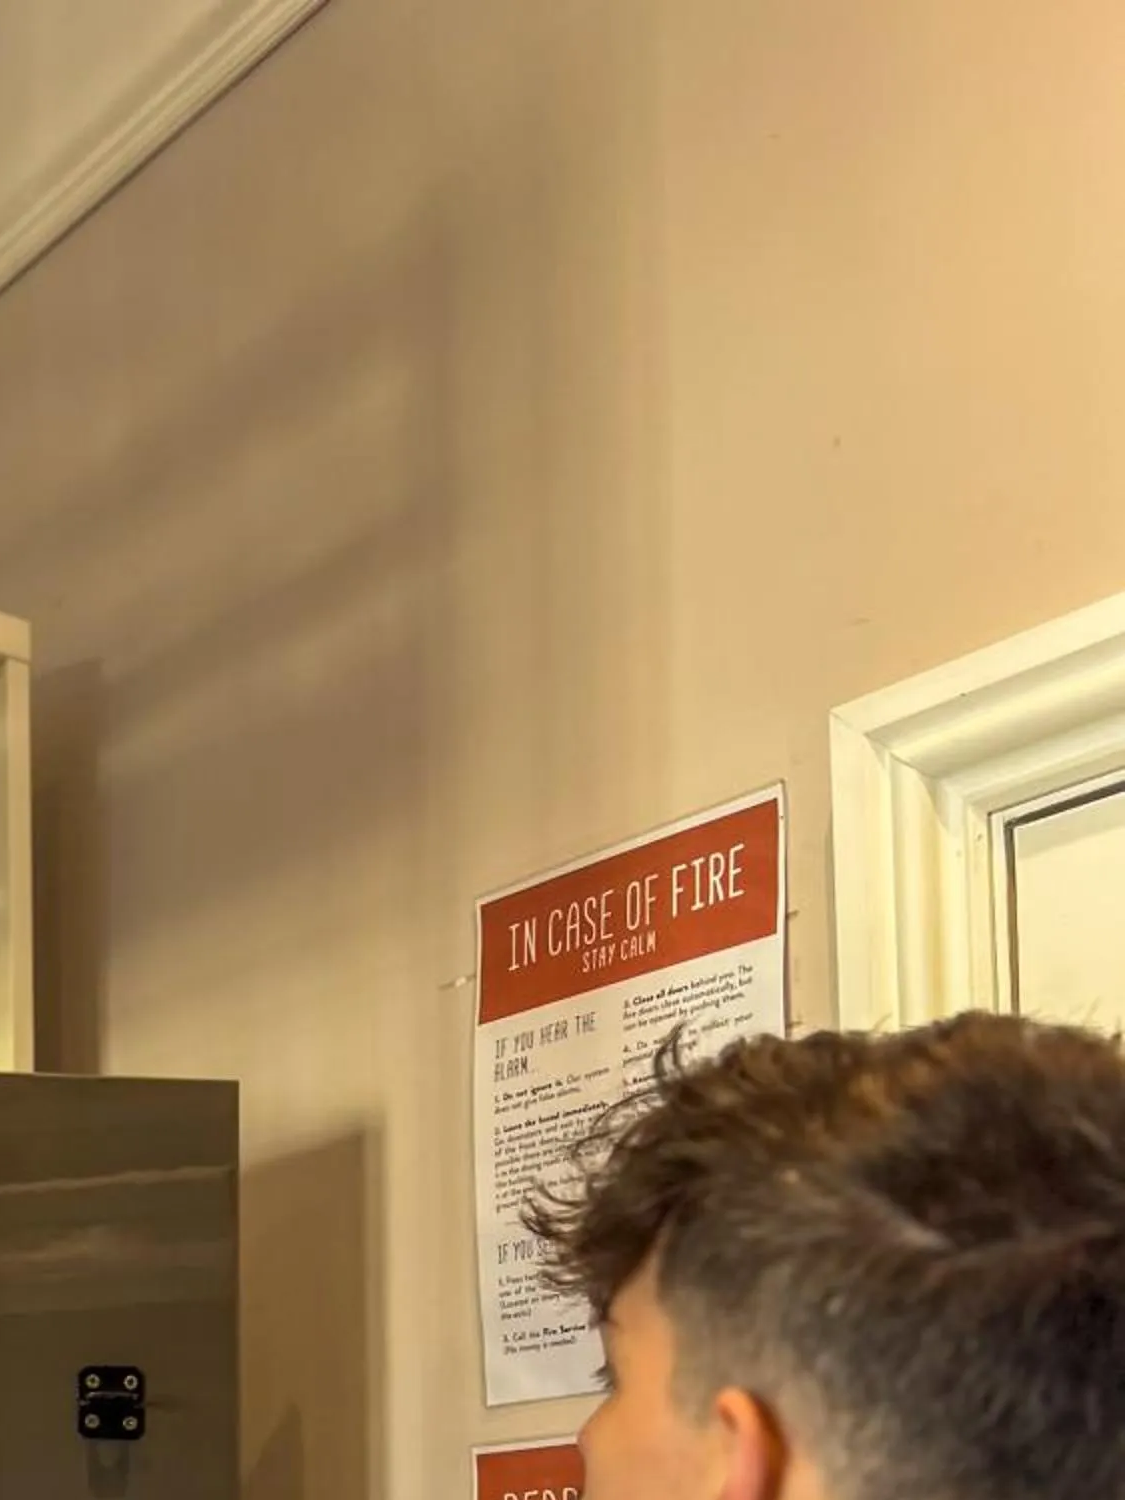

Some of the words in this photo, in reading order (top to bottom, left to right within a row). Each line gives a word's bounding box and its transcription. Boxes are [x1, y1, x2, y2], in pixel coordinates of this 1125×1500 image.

[508, 916, 537, 971] IN
[548, 889, 614, 957] CASE
[626, 874, 659, 931] OF
[672, 843, 745, 919] FIRE
[582, 946, 617, 973] STAY
[620, 930, 657, 961] CALM
[633, 994, 654, 1006] Close
[667, 984, 689, 996] doors
[495, 1037, 508, 1060] IF
[514, 1030, 534, 1054] YOU
[539, 1019, 568, 1045] HEAR
[575, 1011, 596, 1035] THE
[498, 1243, 509, 1265] IF
[512, 1239, 534, 1262] YOU
